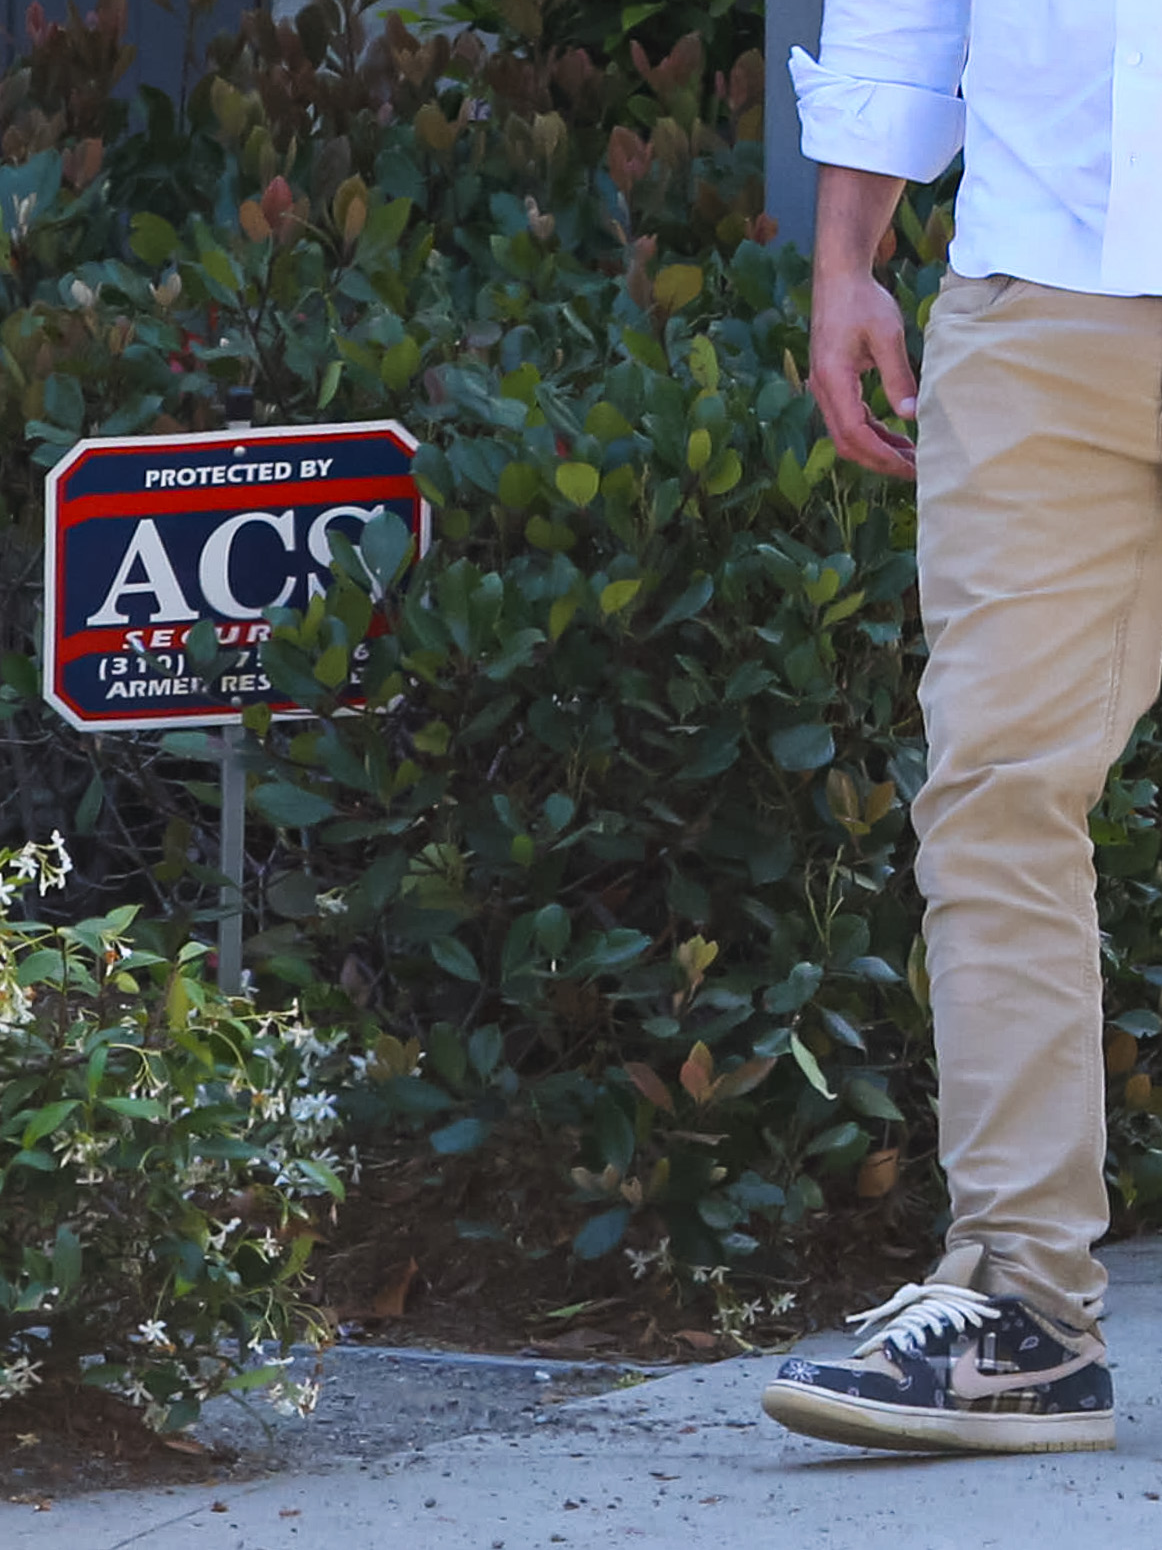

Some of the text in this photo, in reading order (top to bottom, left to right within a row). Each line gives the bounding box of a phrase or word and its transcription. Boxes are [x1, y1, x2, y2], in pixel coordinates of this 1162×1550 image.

[145, 459, 333, 487] PROTECTED BY
[87, 504, 386, 626] ACS
[122, 624, 272, 650] SEUR
